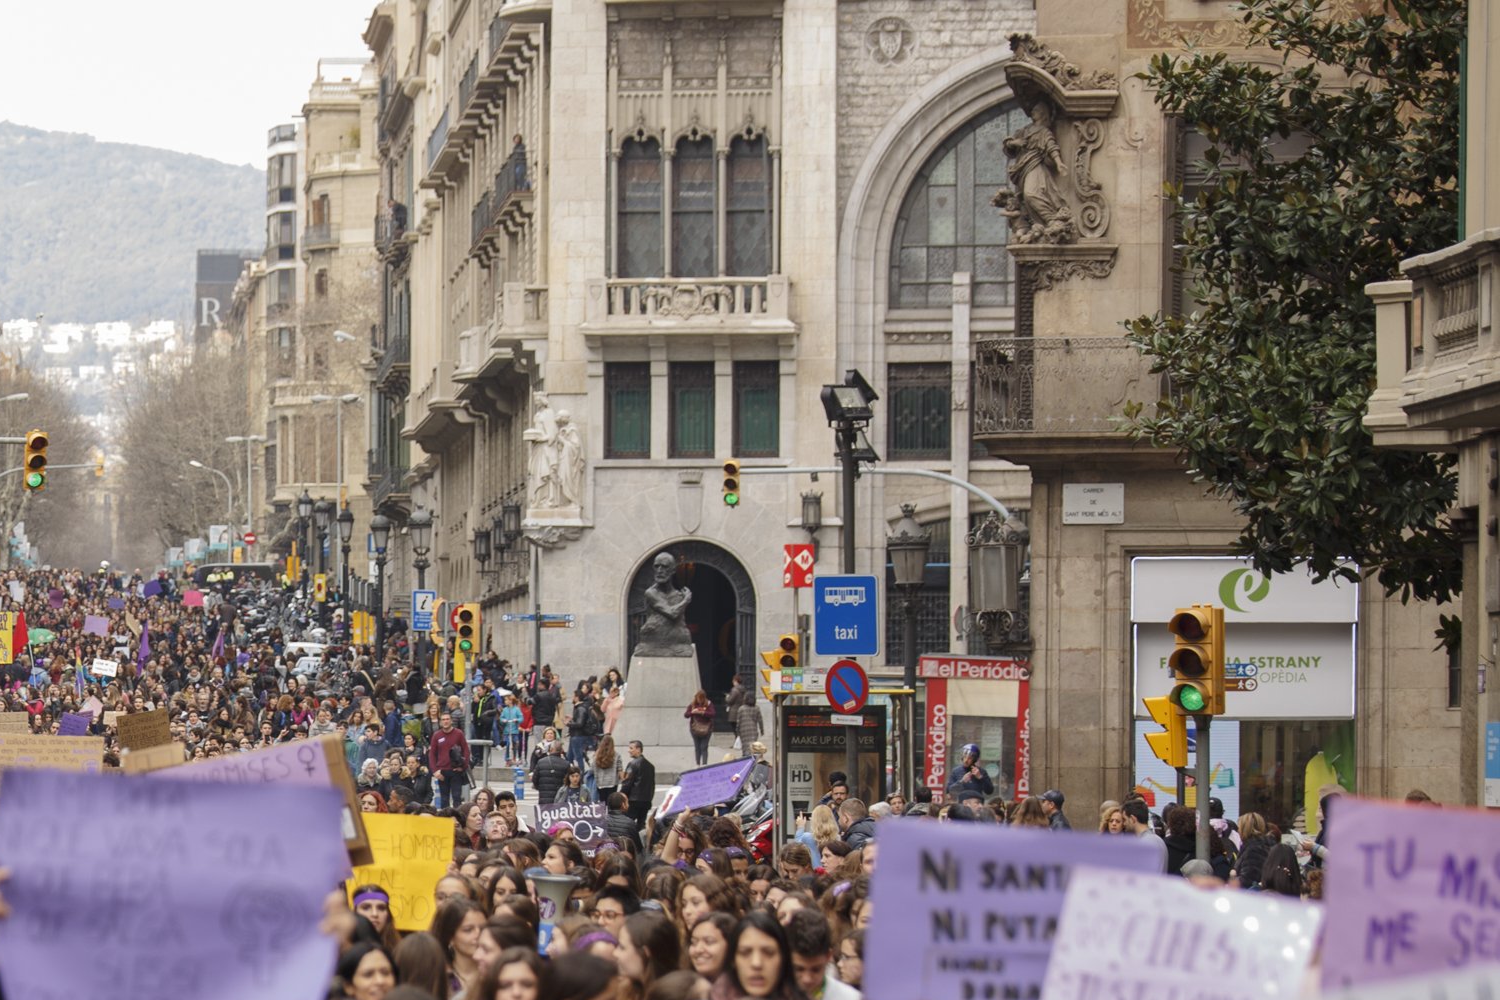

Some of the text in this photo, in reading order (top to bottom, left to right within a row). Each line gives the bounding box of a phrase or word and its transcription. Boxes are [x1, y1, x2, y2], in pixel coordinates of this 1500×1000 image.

[199, 297, 221, 327] R
[834, 625, 858, 640] taxi
[939, 661, 1030, 681] el Periódic
[1249, 656, 1322, 669] ESTRANY
[1260, 670, 1307, 683] OPÈDIA
[790, 735, 875, 745] MAKE UP FO VER
[926, 704, 947, 788] Periódico
[791, 770, 813, 782] HD
[536, 802, 602, 830] Igualtat
[390, 832, 450, 862] HOMBRE
[979, 860, 1068, 892] SANT
[1357, 835, 1500, 910] TU MI
[1364, 911, 1500, 968] ME SE
